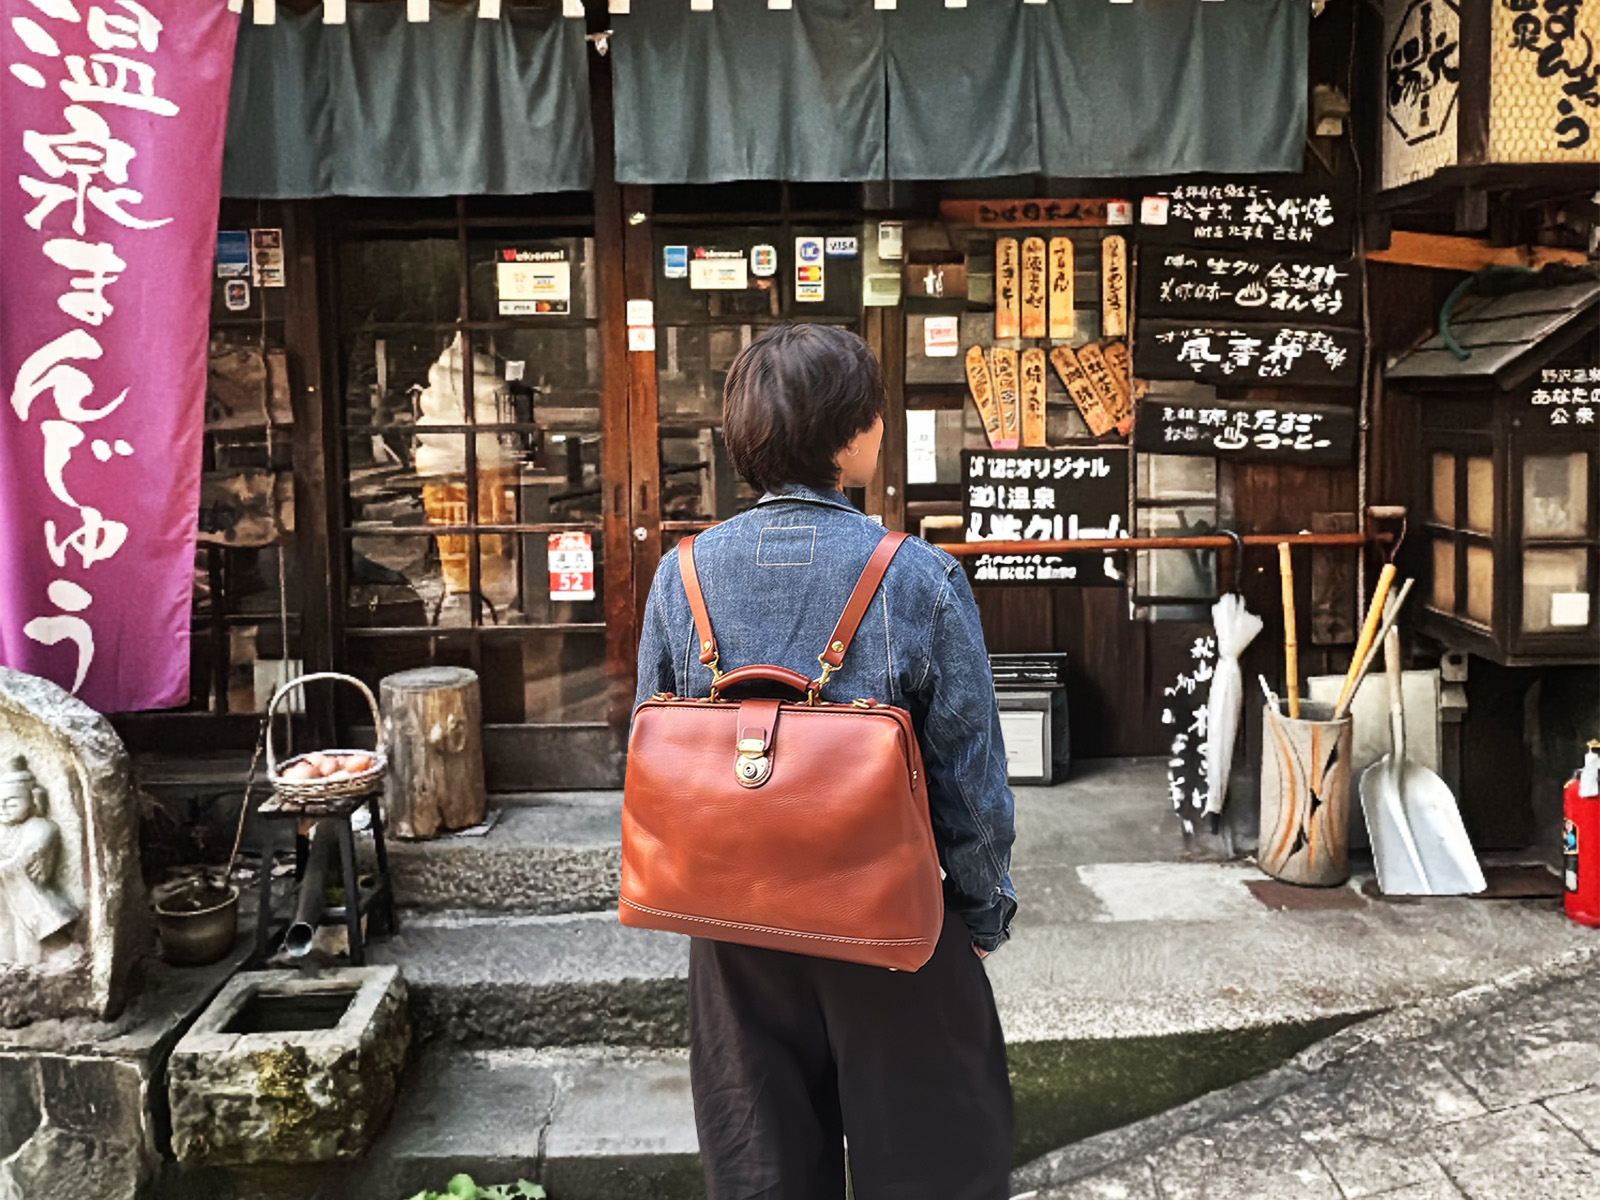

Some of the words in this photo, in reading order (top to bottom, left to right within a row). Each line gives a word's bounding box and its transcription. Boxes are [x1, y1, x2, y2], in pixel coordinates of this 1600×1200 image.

[9, 0, 180, 697] 温泉まんじゅう
[1253, 433, 1332, 450] コーヒー
[559, 573, 584, 591] 52
